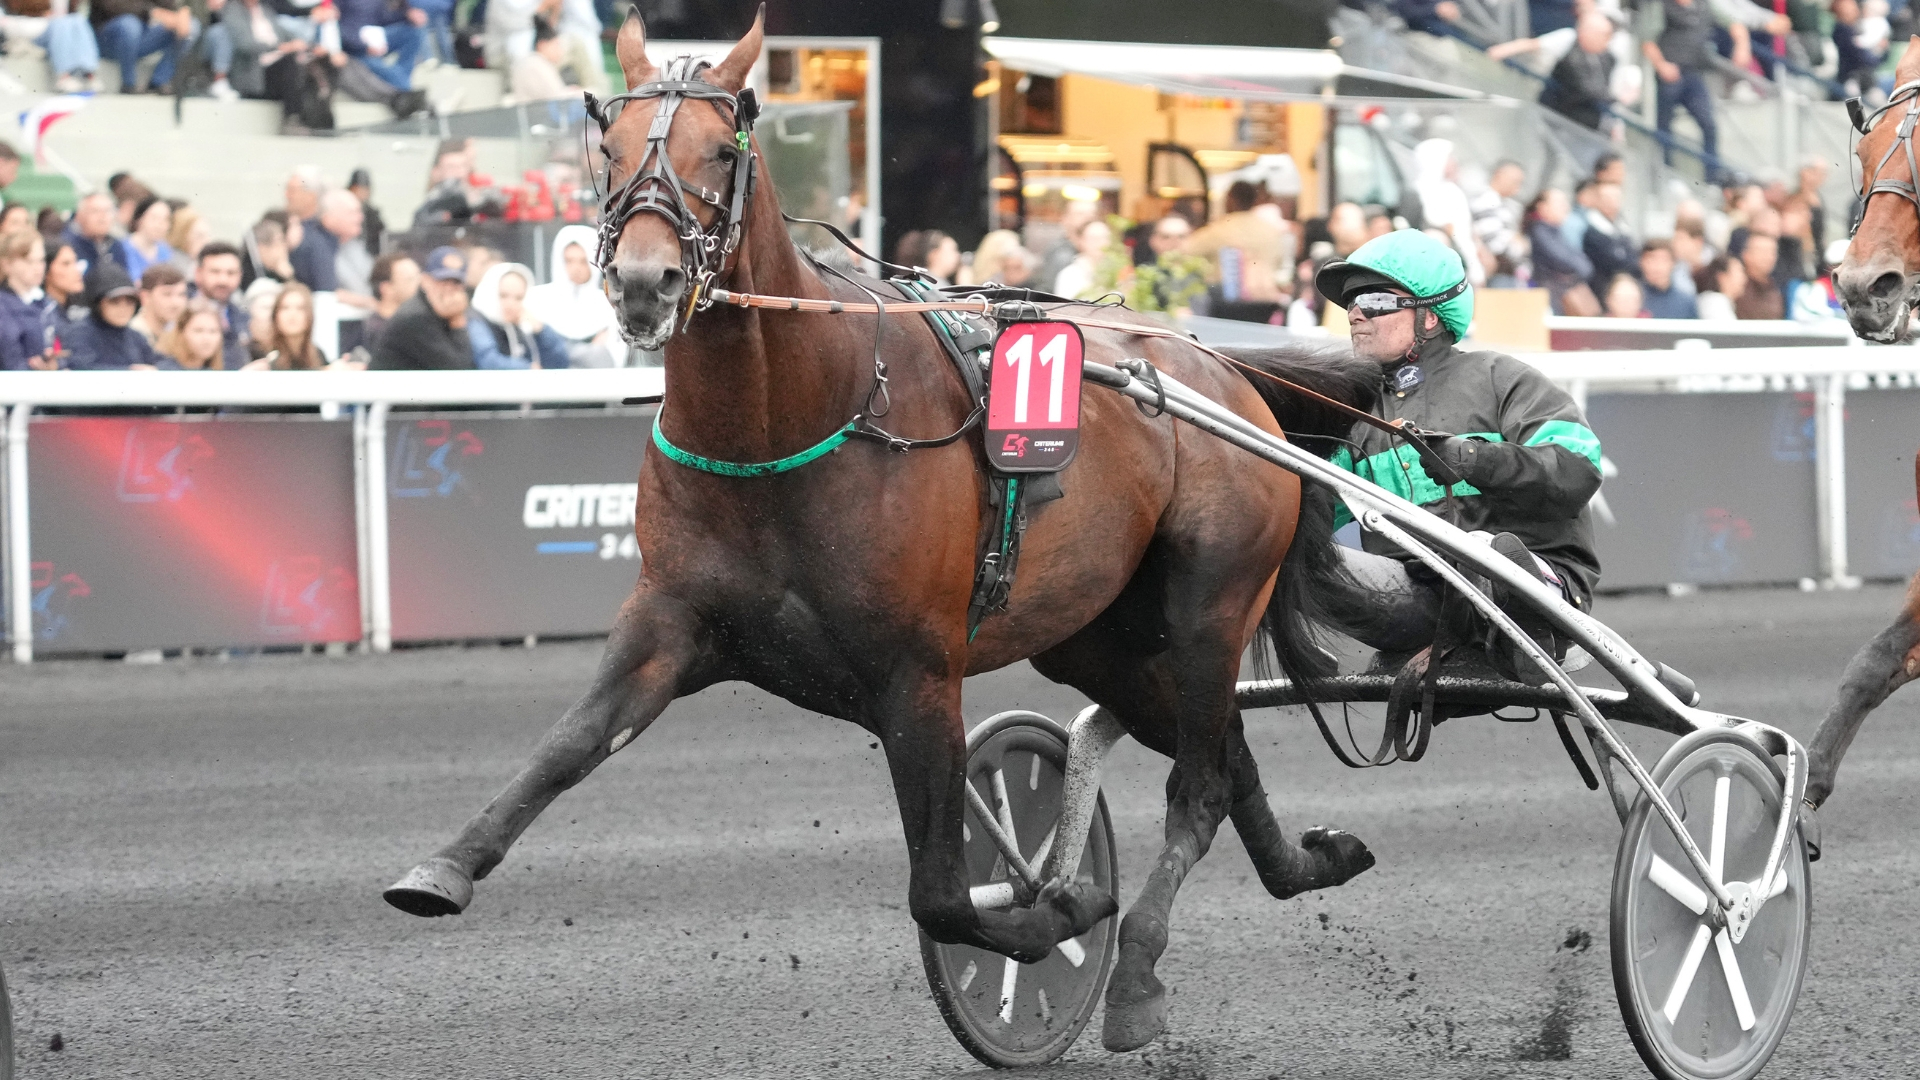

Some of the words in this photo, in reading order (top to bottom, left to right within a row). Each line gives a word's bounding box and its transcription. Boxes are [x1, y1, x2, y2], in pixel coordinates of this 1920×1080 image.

[1417, 294, 1448, 305] FINNTACK
[1005, 333, 1068, 423] 11
[599, 532, 642, 560] 34
